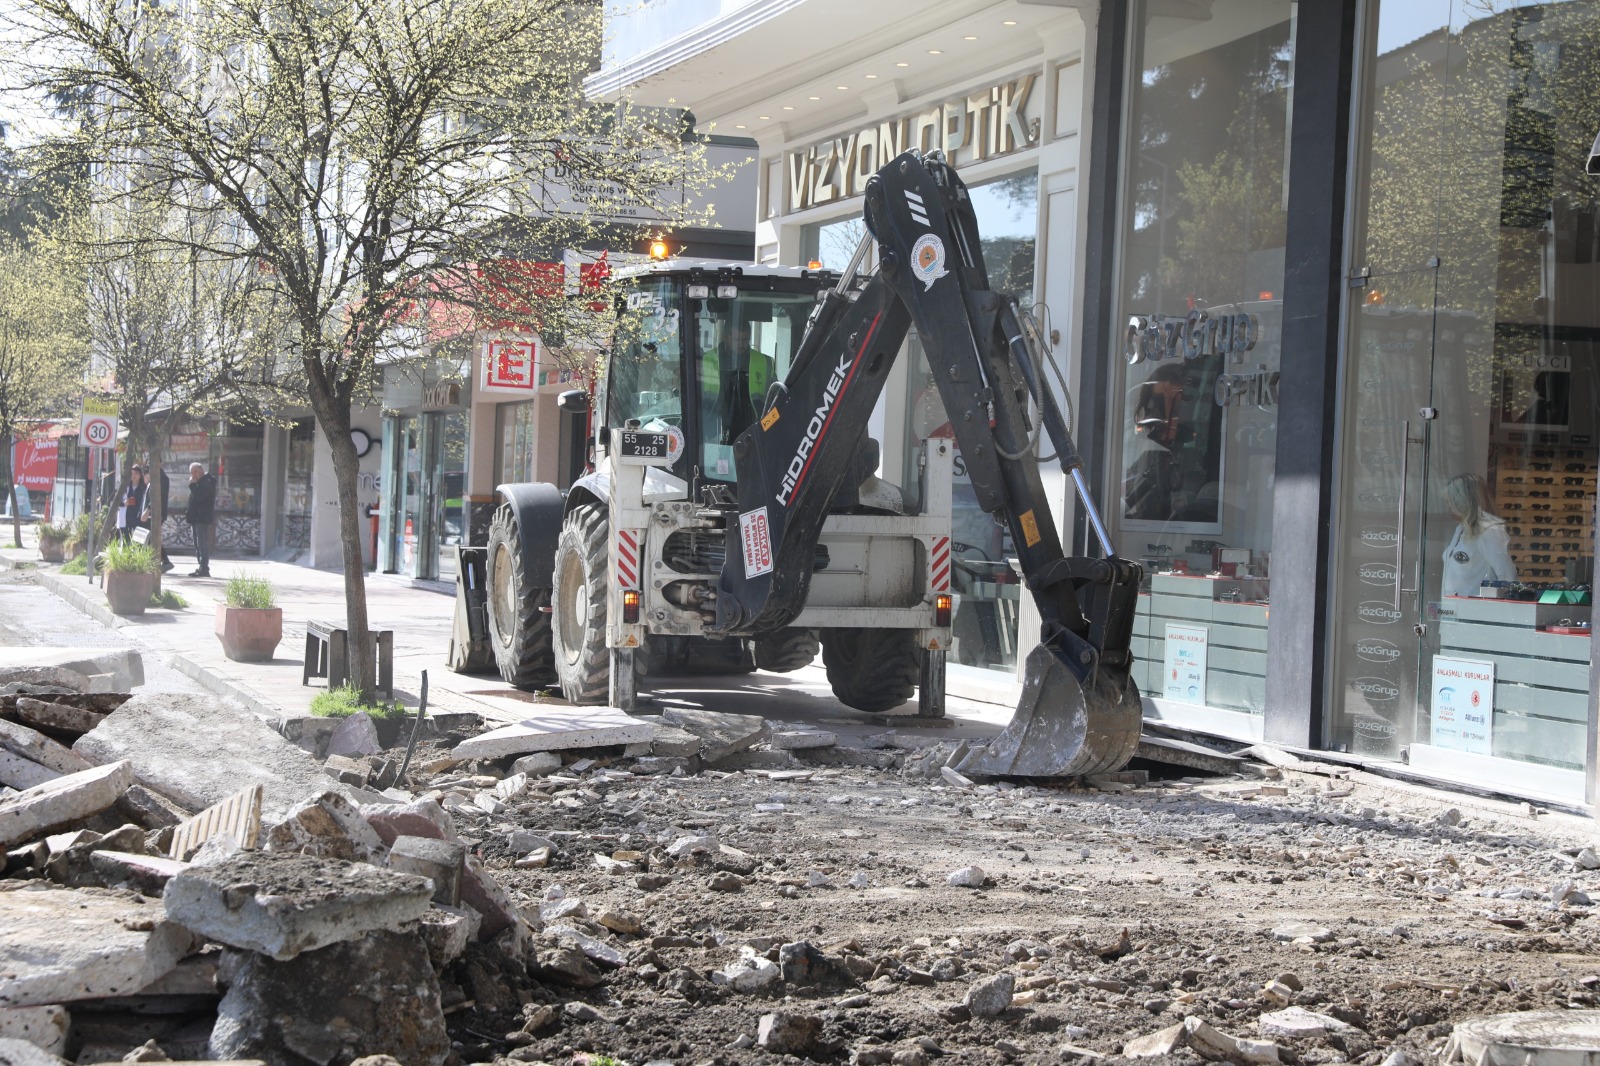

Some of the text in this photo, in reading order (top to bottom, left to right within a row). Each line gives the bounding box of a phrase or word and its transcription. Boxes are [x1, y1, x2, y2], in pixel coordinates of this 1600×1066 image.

[1125, 309, 1259, 365] GözGrup
[498, 349, 524, 381] E
[90, 425, 107, 440] 30
[624, 434, 665, 445] 55 25
[634, 446, 658, 456] 2128
[750, 514, 757, 524] 25
[1355, 606, 1402, 620] GözGrup
[1353, 643, 1400, 659] GözGrup
[1351, 681, 1399, 697] GözGrup
[1352, 719, 1398, 735] GözGrup
